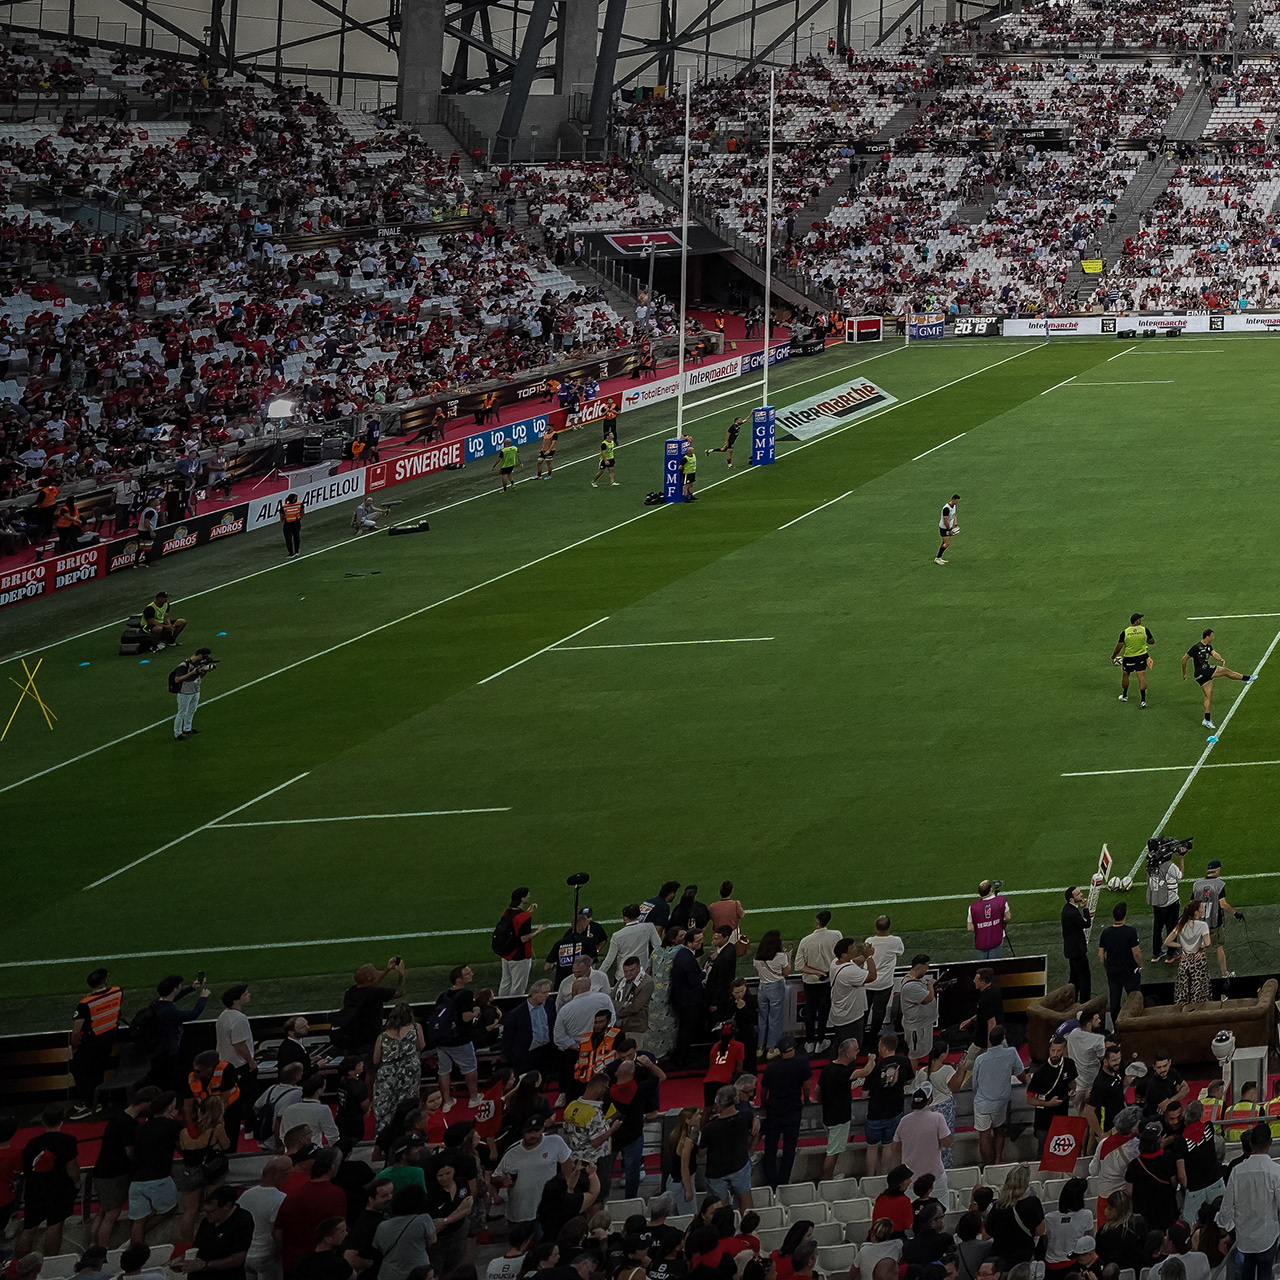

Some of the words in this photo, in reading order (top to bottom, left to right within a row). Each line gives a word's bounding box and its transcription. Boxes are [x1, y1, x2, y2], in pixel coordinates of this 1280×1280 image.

[378, 227, 400, 237] FINALE
[919, 327, 943, 337] GMF
[1139, 320, 1188, 328] Intermarché
[689, 361, 738, 386] Intermarché
[641, 381, 680, 401] TotalEnergie
[776, 382, 880, 430] Intermarché
[755, 426, 766, 461] GMF
[395, 443, 461, 481] SYNERGIE
[667, 459, 678, 498] GMF
[301, 478, 360, 508] AFFLELOU
[210, 519, 244, 539] ANDROS
[162, 535, 198, 554] ANDROS
[56, 550, 98, 572] BRICO
[1, 565, 46, 590] BRICO
[55, 564, 98, 589] DEPÔT
[0, 580, 45, 605] DEPÔT
